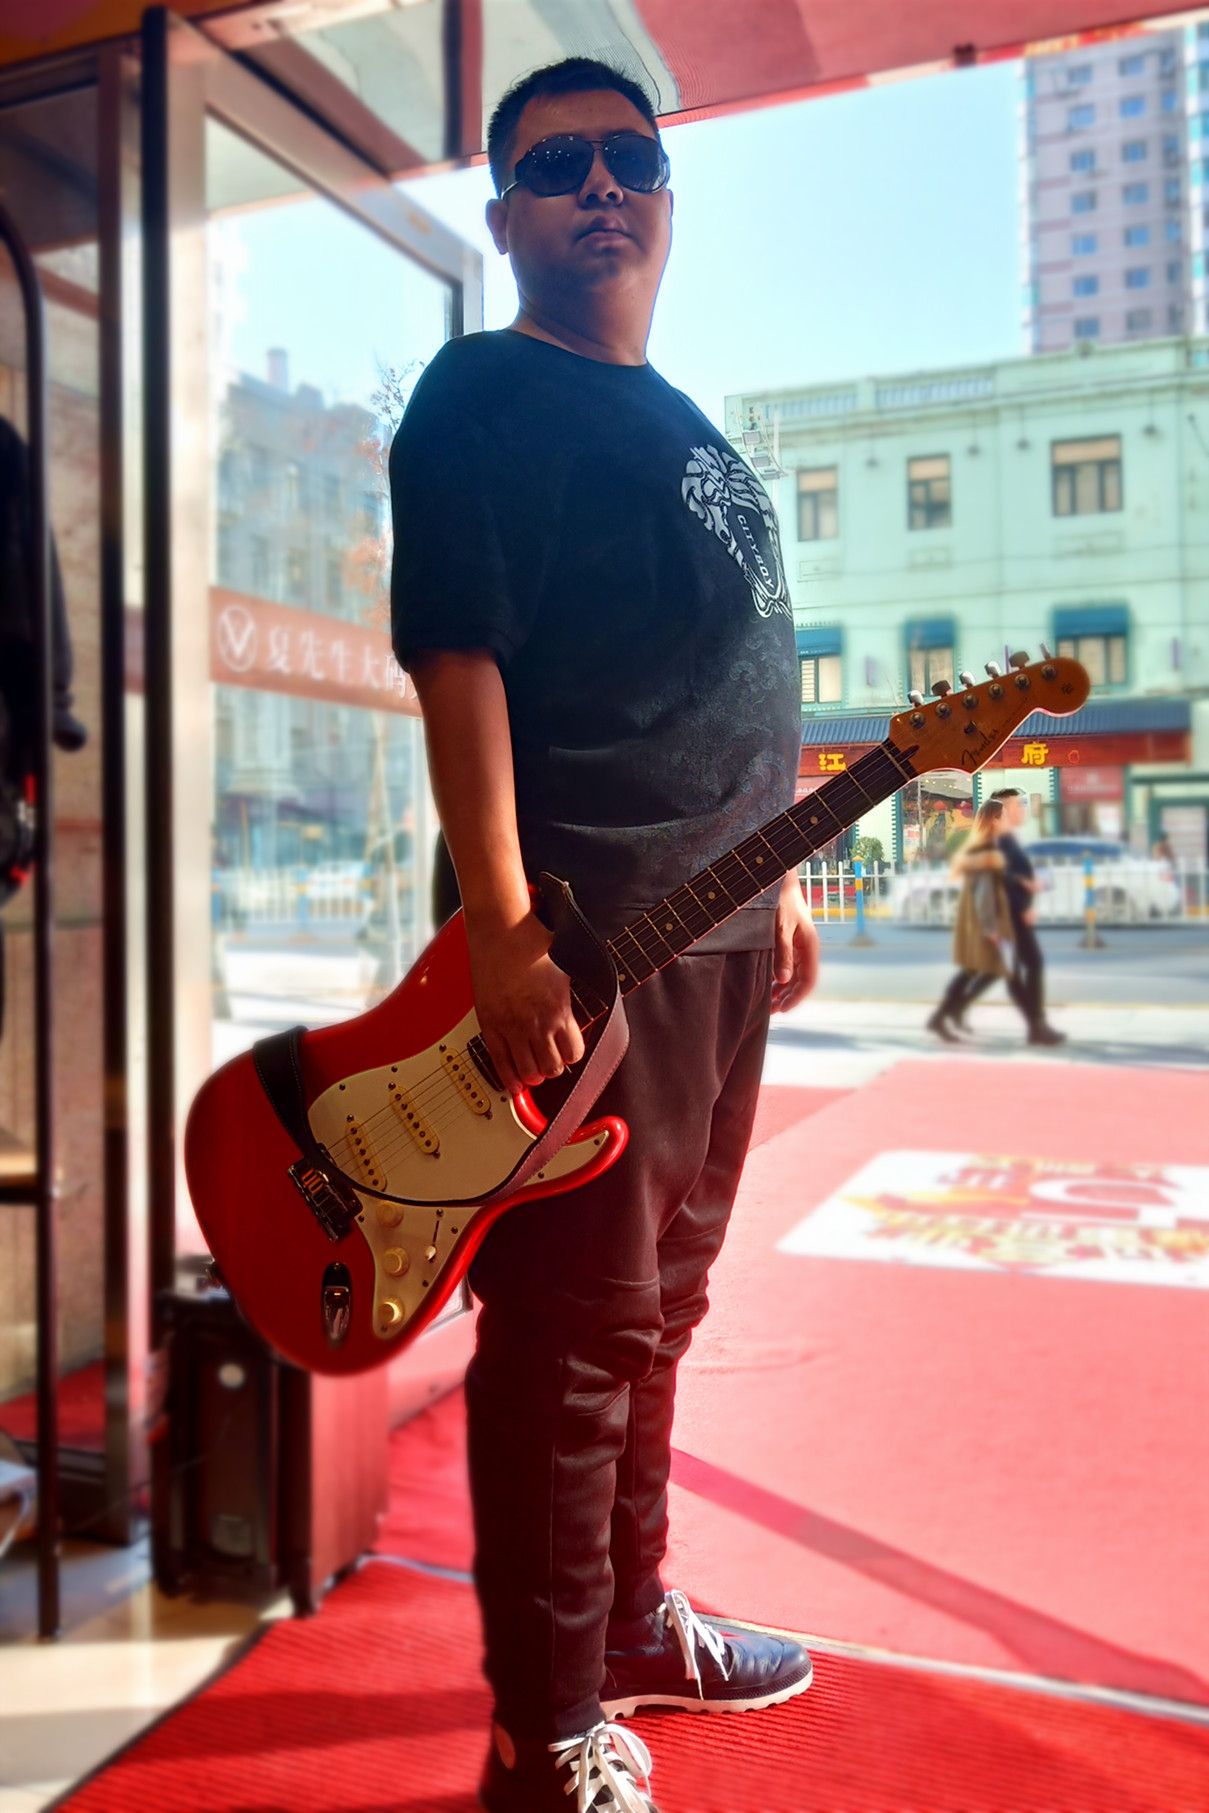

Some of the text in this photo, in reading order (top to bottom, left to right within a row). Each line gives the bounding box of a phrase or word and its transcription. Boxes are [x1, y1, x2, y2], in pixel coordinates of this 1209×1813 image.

[737, 514, 775, 589] CITYBOY
[269, 626, 418, 700] 夏先生大码
[818, 741, 1049, 771] 江 府
